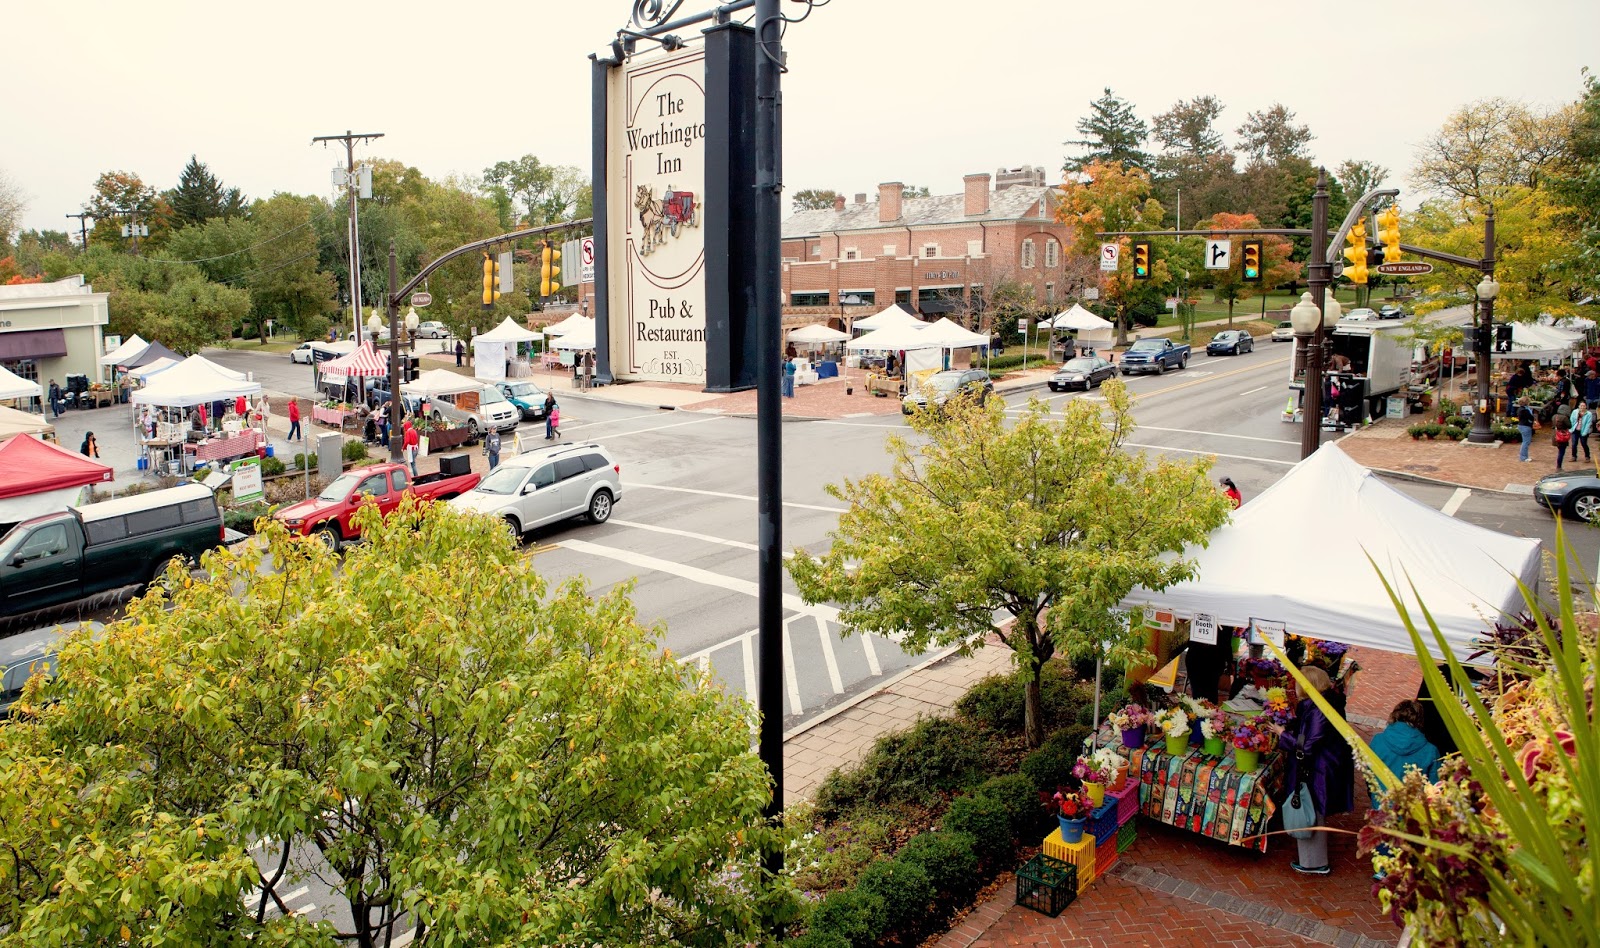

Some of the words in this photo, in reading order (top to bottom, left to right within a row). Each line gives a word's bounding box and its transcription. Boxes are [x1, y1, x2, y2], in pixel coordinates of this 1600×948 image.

[656, 91, 684, 117] The
[626, 121, 705, 151] Worthingto
[656, 152, 682, 175] Inn
[648, 297, 675, 319] Pub
[680, 300, 693, 318] &
[663, 350, 679, 360] EST.
[660, 362, 682, 375] 1831
[1195, 620, 1213, 629] Booth
